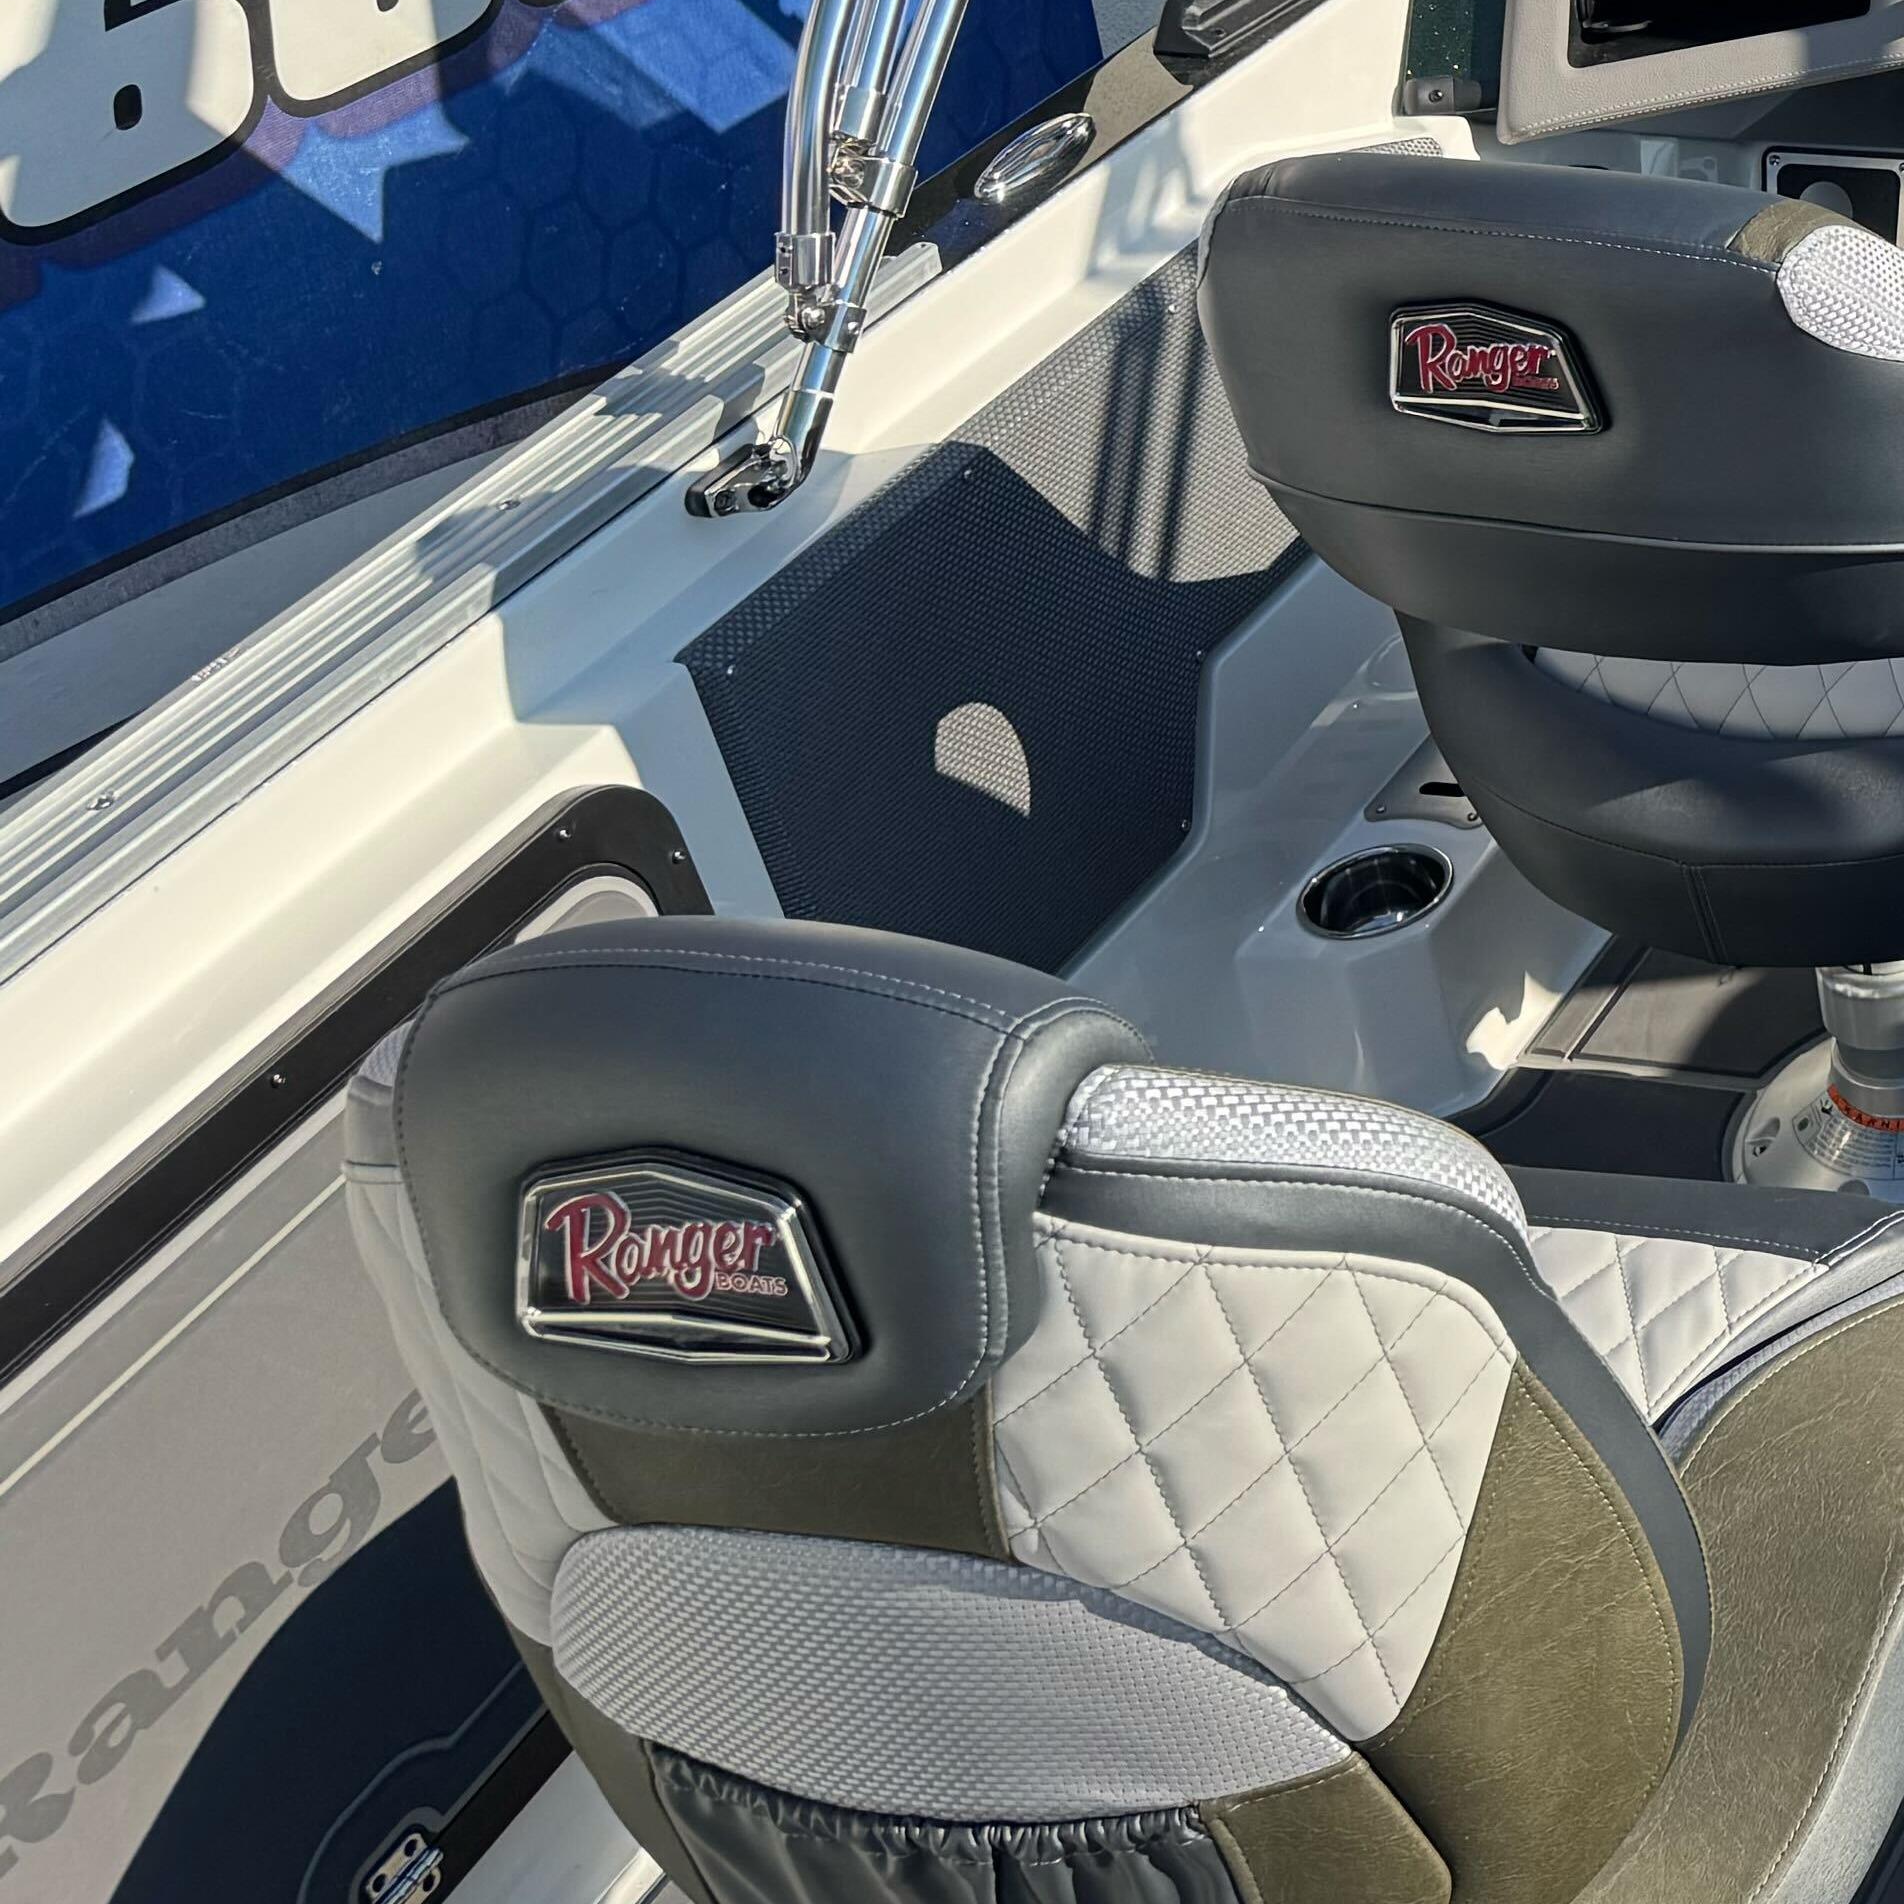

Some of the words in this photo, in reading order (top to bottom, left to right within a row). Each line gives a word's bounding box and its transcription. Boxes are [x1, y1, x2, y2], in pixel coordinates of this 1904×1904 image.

[1404, 323, 1556, 393] Ranger
[545, 1191, 776, 1304] Ranger
[714, 1272, 788, 1296] BOATS
